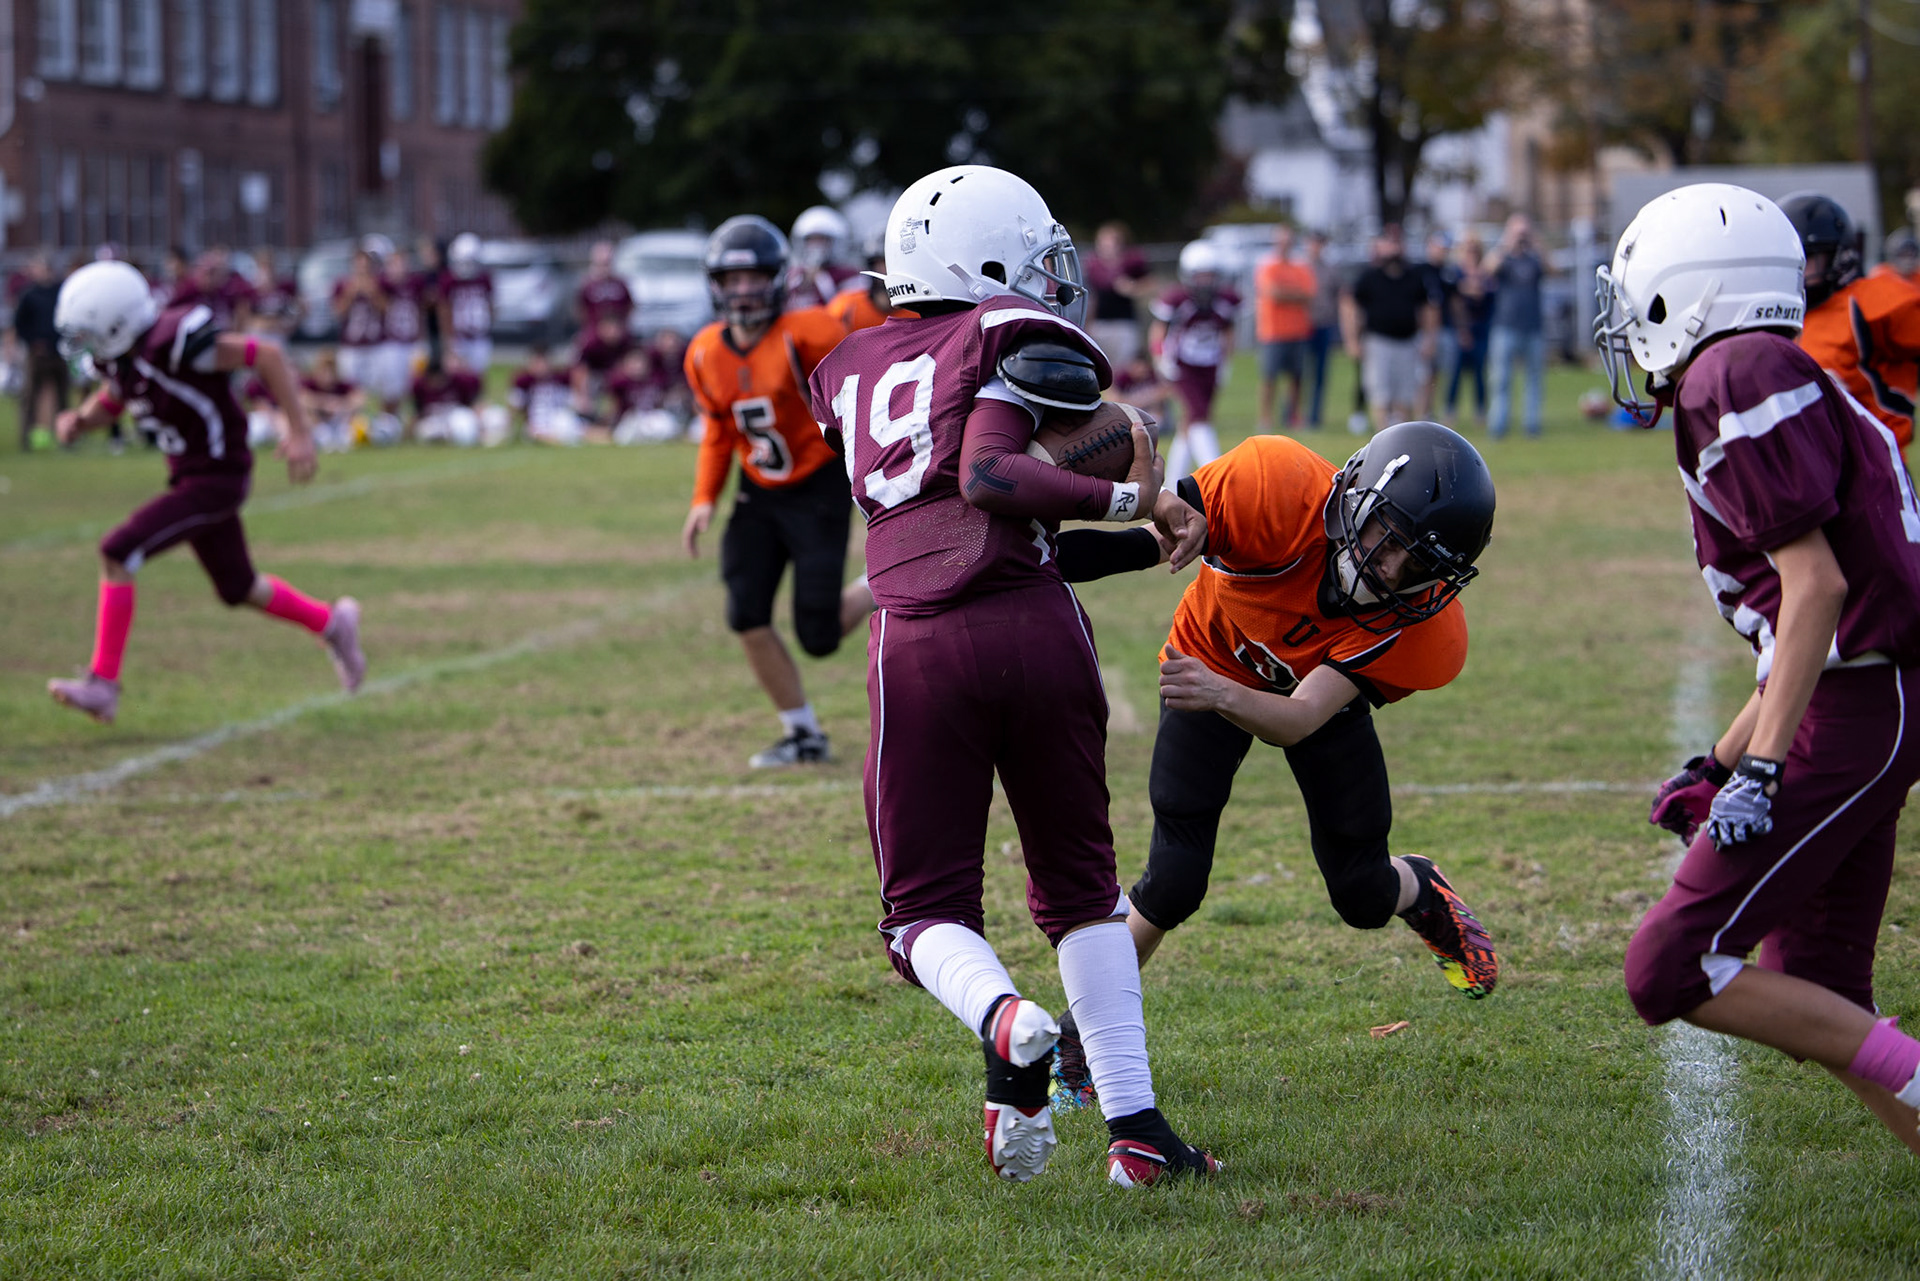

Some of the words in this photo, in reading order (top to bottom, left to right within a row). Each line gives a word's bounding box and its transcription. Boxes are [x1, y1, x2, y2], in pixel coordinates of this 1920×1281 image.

[887, 283, 917, 298] ENITH
[731, 396, 794, 481] 5
[831, 353, 937, 510] 19
[1282, 615, 1321, 648] U
